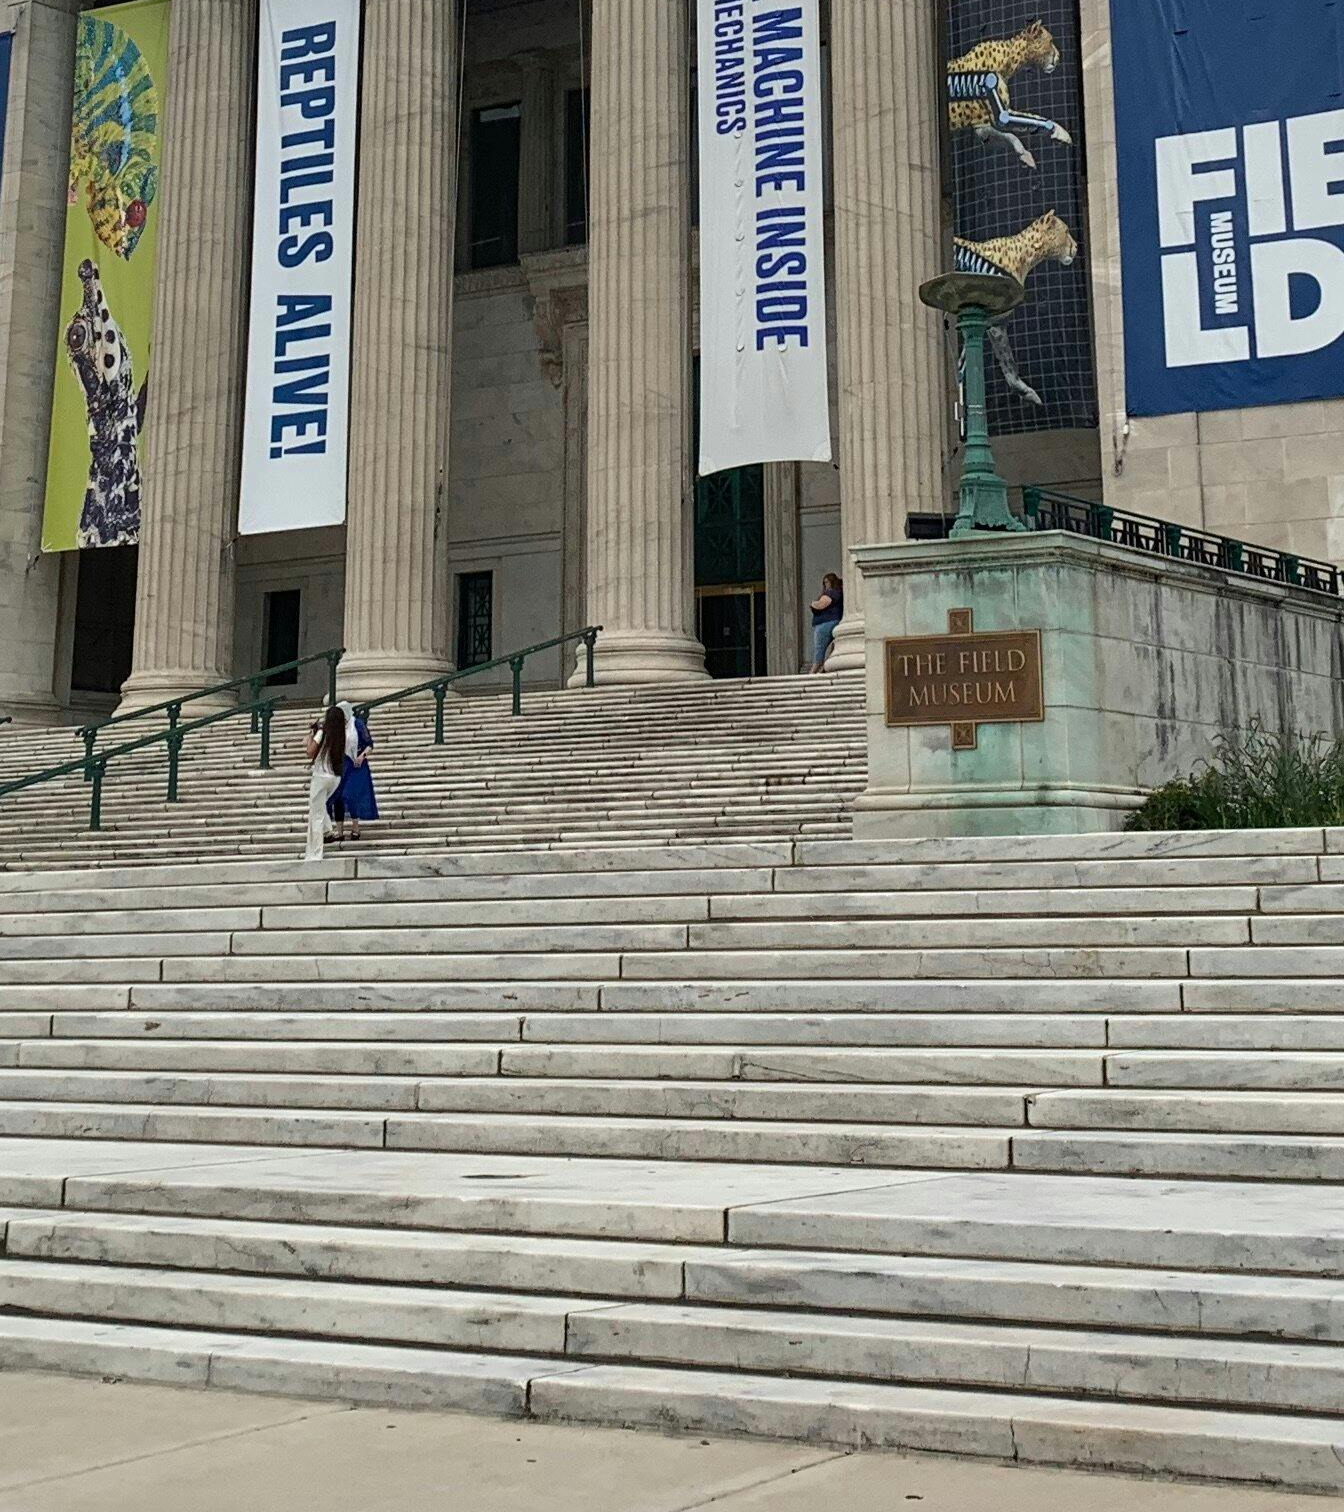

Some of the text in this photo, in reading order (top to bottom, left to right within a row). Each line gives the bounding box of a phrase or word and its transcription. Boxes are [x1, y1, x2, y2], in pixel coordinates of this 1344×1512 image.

[751, 5, 806, 198] MACHINE
[269, 20, 337, 460] REPTILES ALIVE!
[755, 207, 809, 353] INSIDE
[1210, 210, 1239, 315] MUSEUM
[898, 649, 1026, 676] THE FIELD
[909, 680, 1016, 706] MUSEUM
